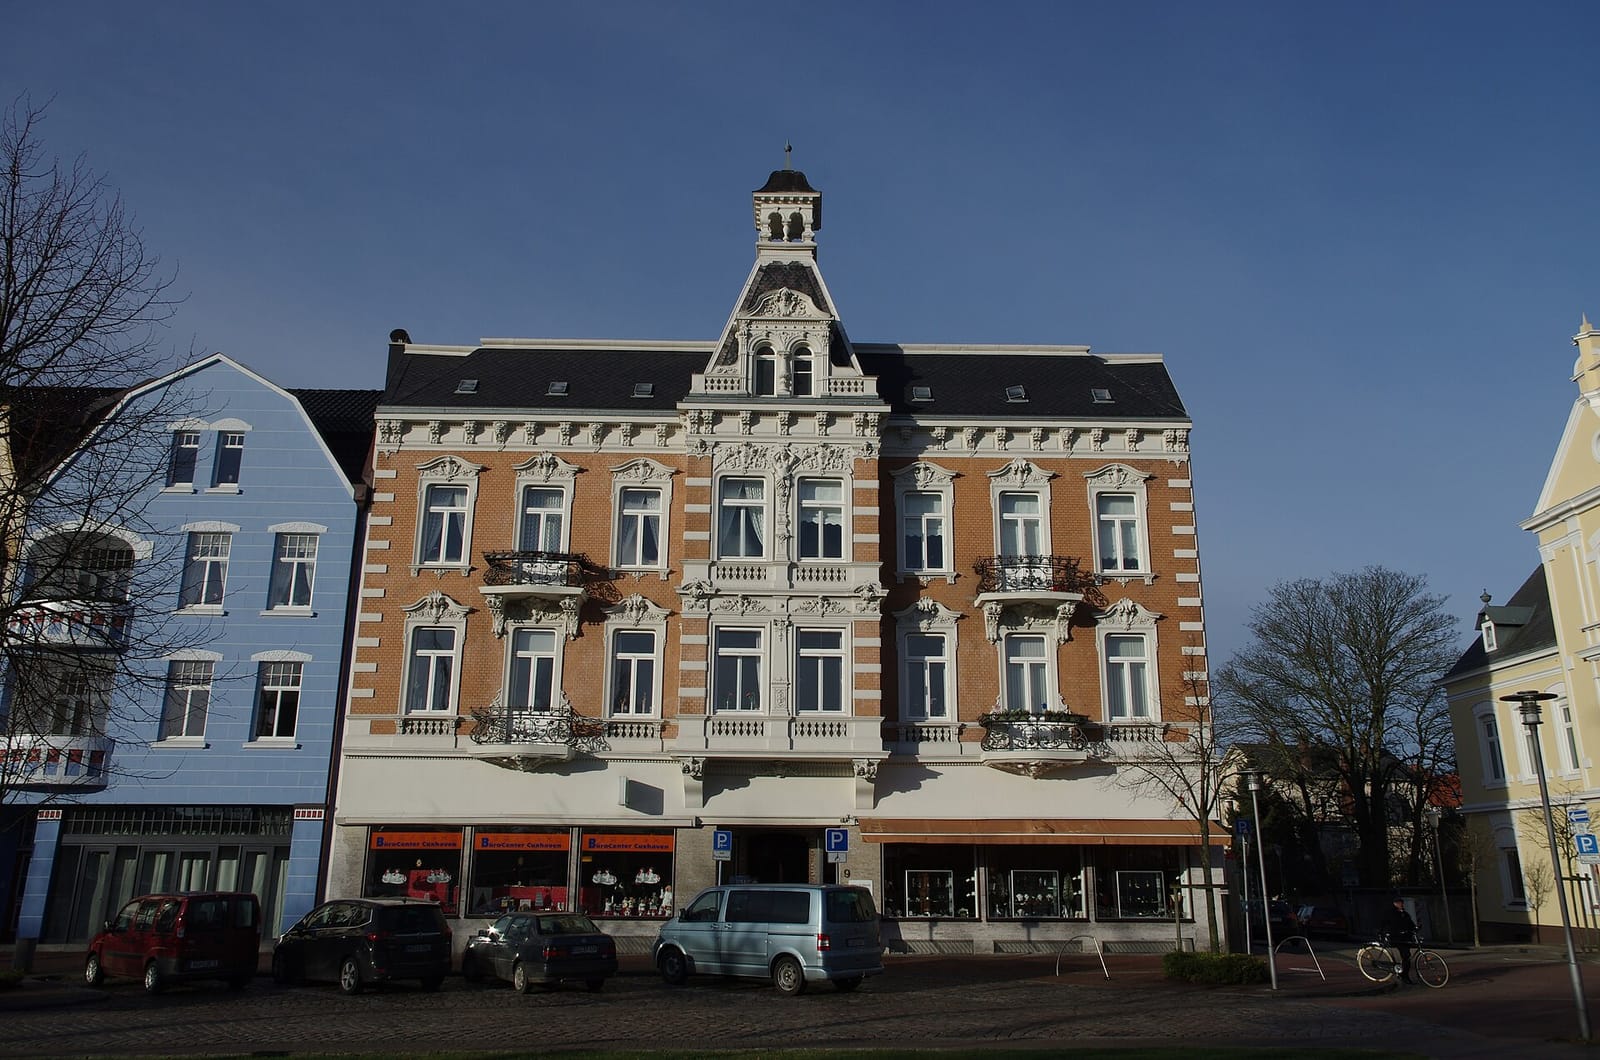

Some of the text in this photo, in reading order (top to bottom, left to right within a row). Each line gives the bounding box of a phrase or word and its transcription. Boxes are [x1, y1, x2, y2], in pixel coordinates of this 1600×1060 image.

[1238, 821, 1247, 833] P
[717, 833, 727, 848] P
[831, 831, 843, 849] P
[1580, 837, 1592, 852] P
[844, 869, 851, 878] 9
